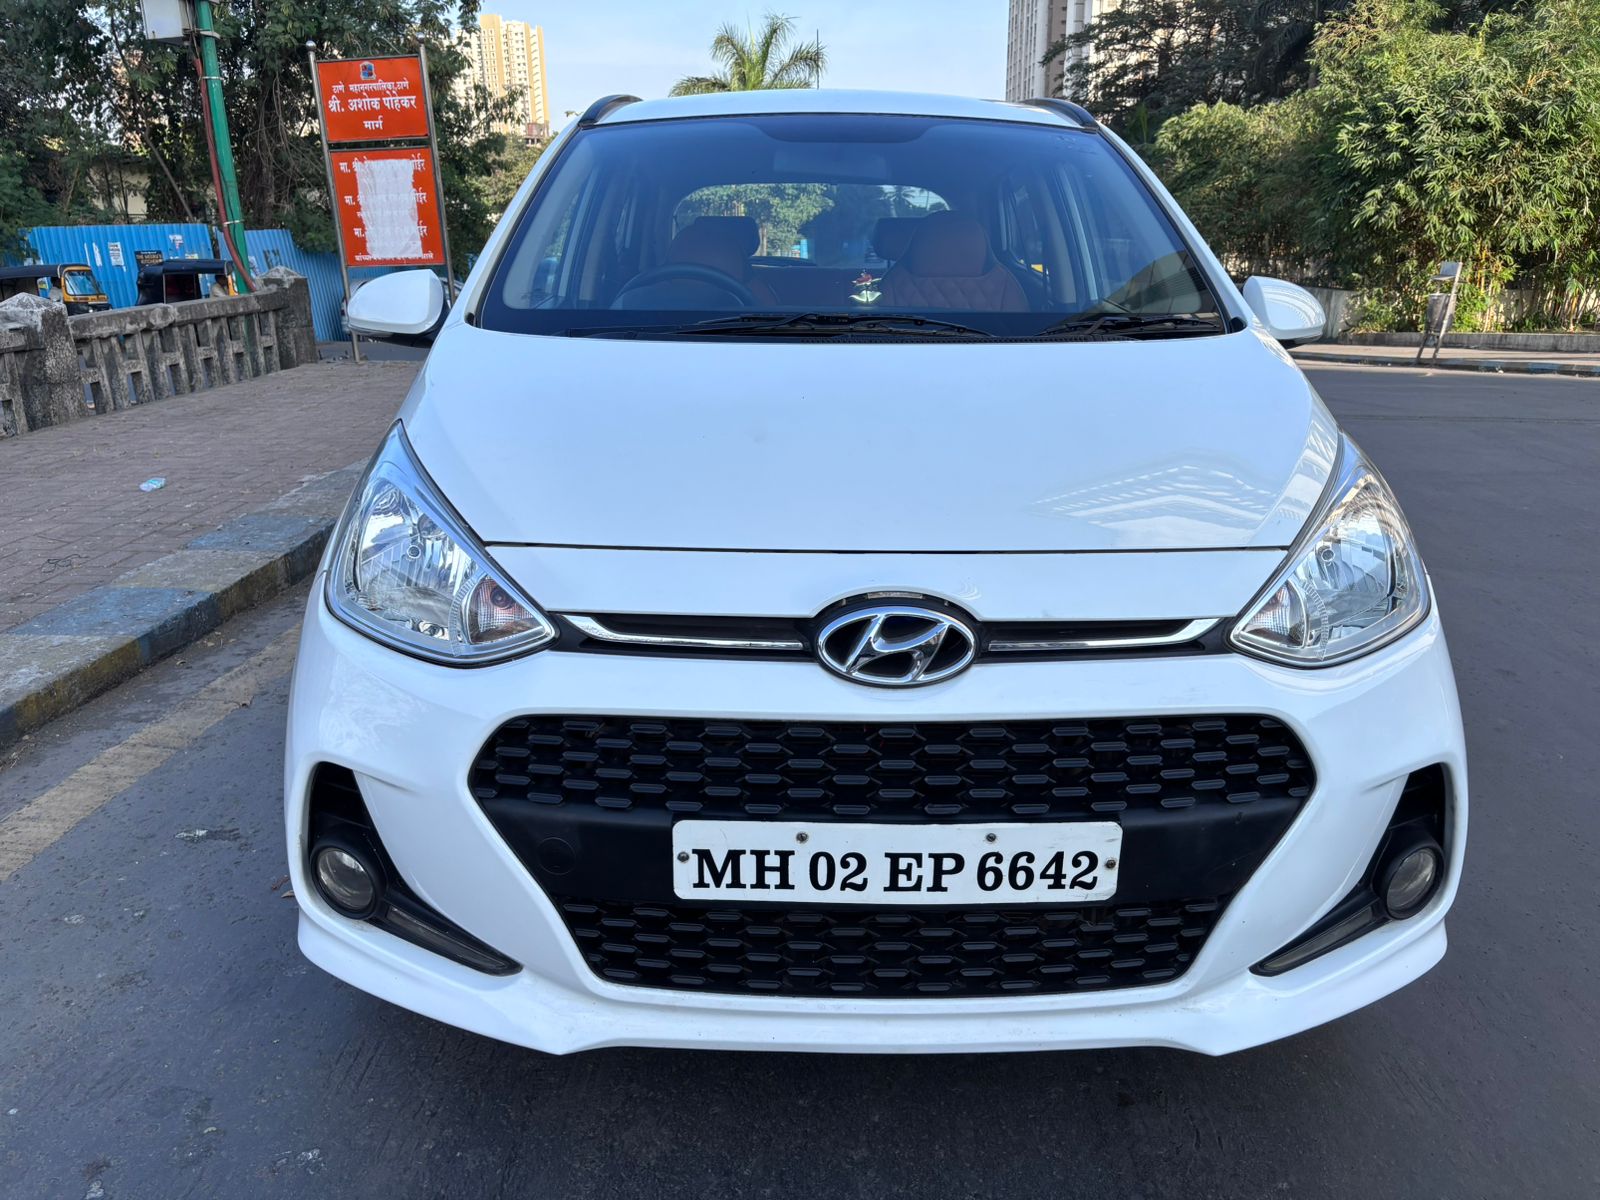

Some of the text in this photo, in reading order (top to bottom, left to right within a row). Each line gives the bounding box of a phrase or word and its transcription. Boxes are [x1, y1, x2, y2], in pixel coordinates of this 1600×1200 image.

[332, 81, 345, 93] ठाणे
[328, 90, 417, 112] श्री. अशोक पोहेकर
[363, 115, 383, 130] मार्ग
[692, 848, 1099, 892] MH 02 EP 6642
